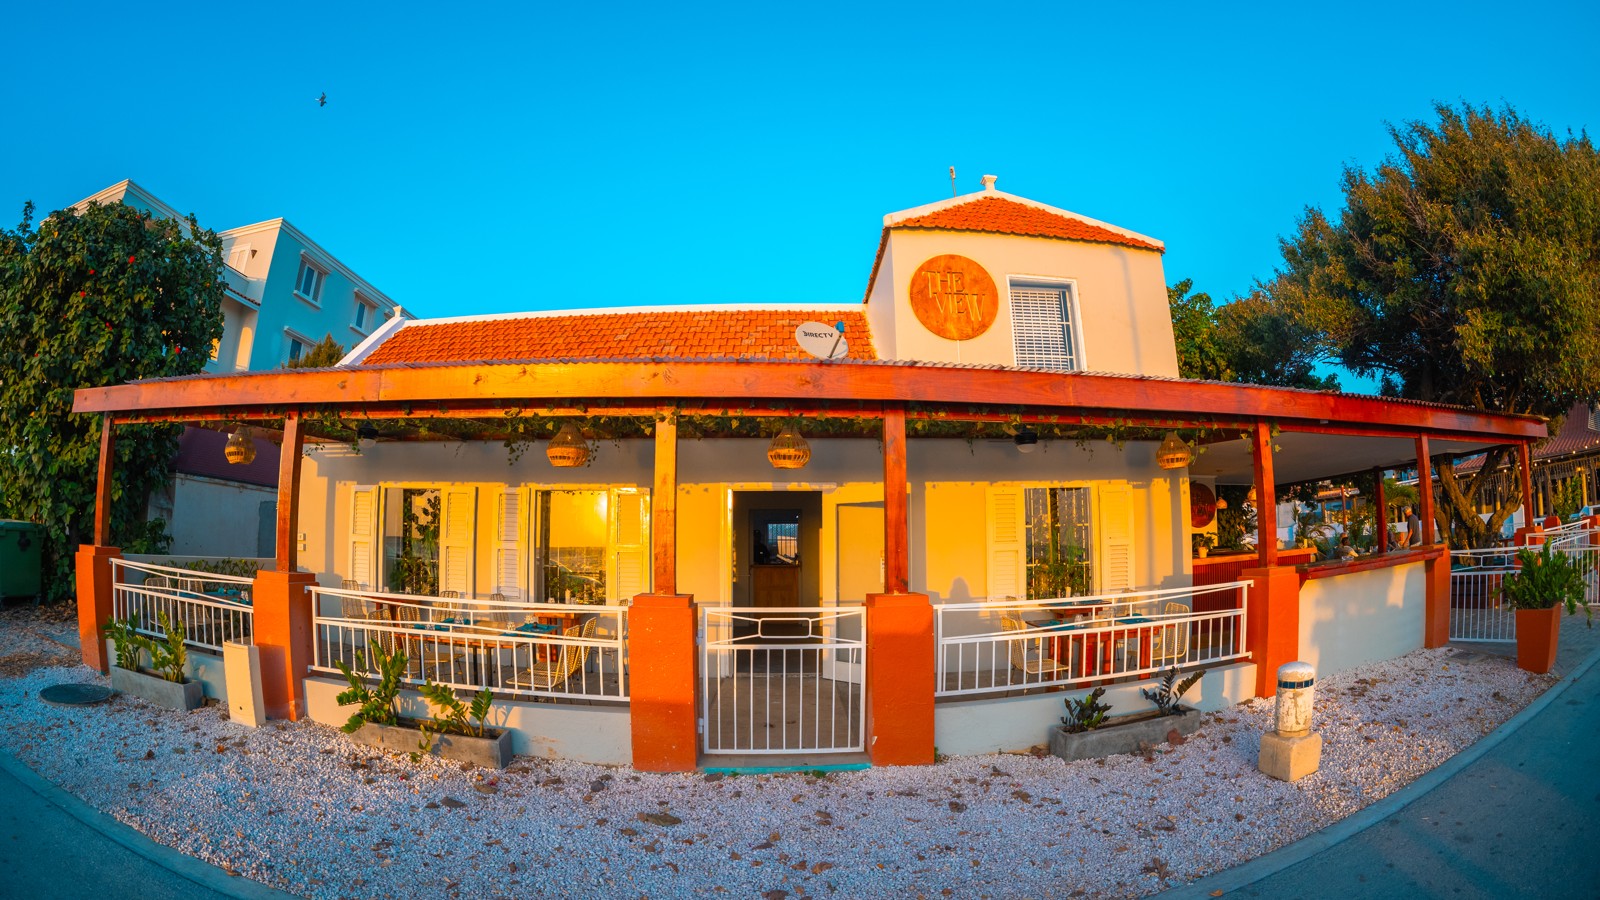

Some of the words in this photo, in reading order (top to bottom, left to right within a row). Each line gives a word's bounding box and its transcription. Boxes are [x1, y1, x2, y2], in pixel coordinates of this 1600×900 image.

[921, 270, 965, 298] THE
[932, 292, 986, 321] VIEW
[802, 330, 834, 339] DIRECTV
